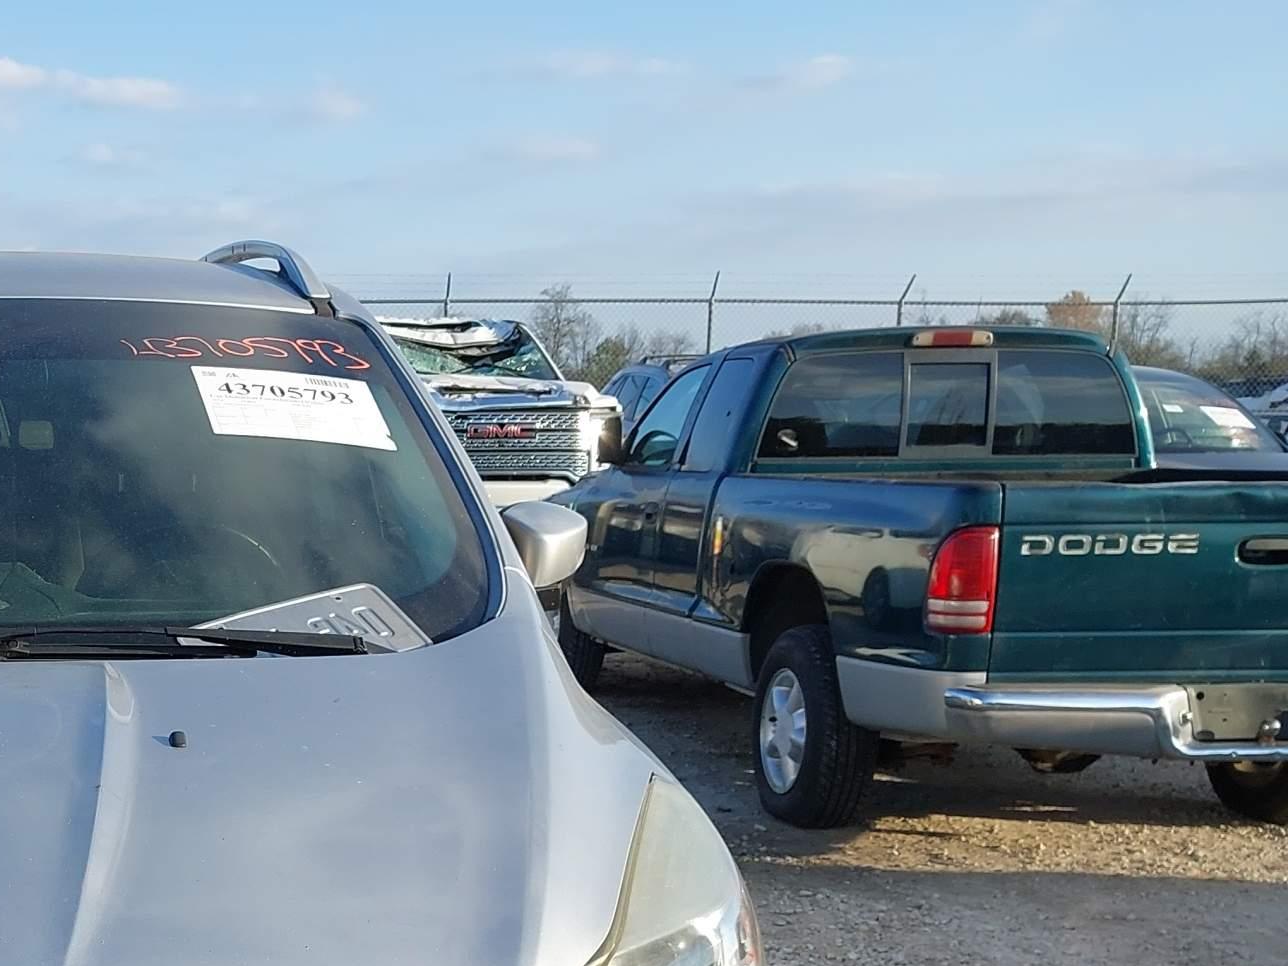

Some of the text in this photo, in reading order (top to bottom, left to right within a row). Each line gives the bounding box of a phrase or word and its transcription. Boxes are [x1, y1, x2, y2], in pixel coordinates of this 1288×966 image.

[217, 382, 354, 405] 43705793
[467, 424, 536, 438] GMC
[1021, 533, 1200, 555] DODGE
